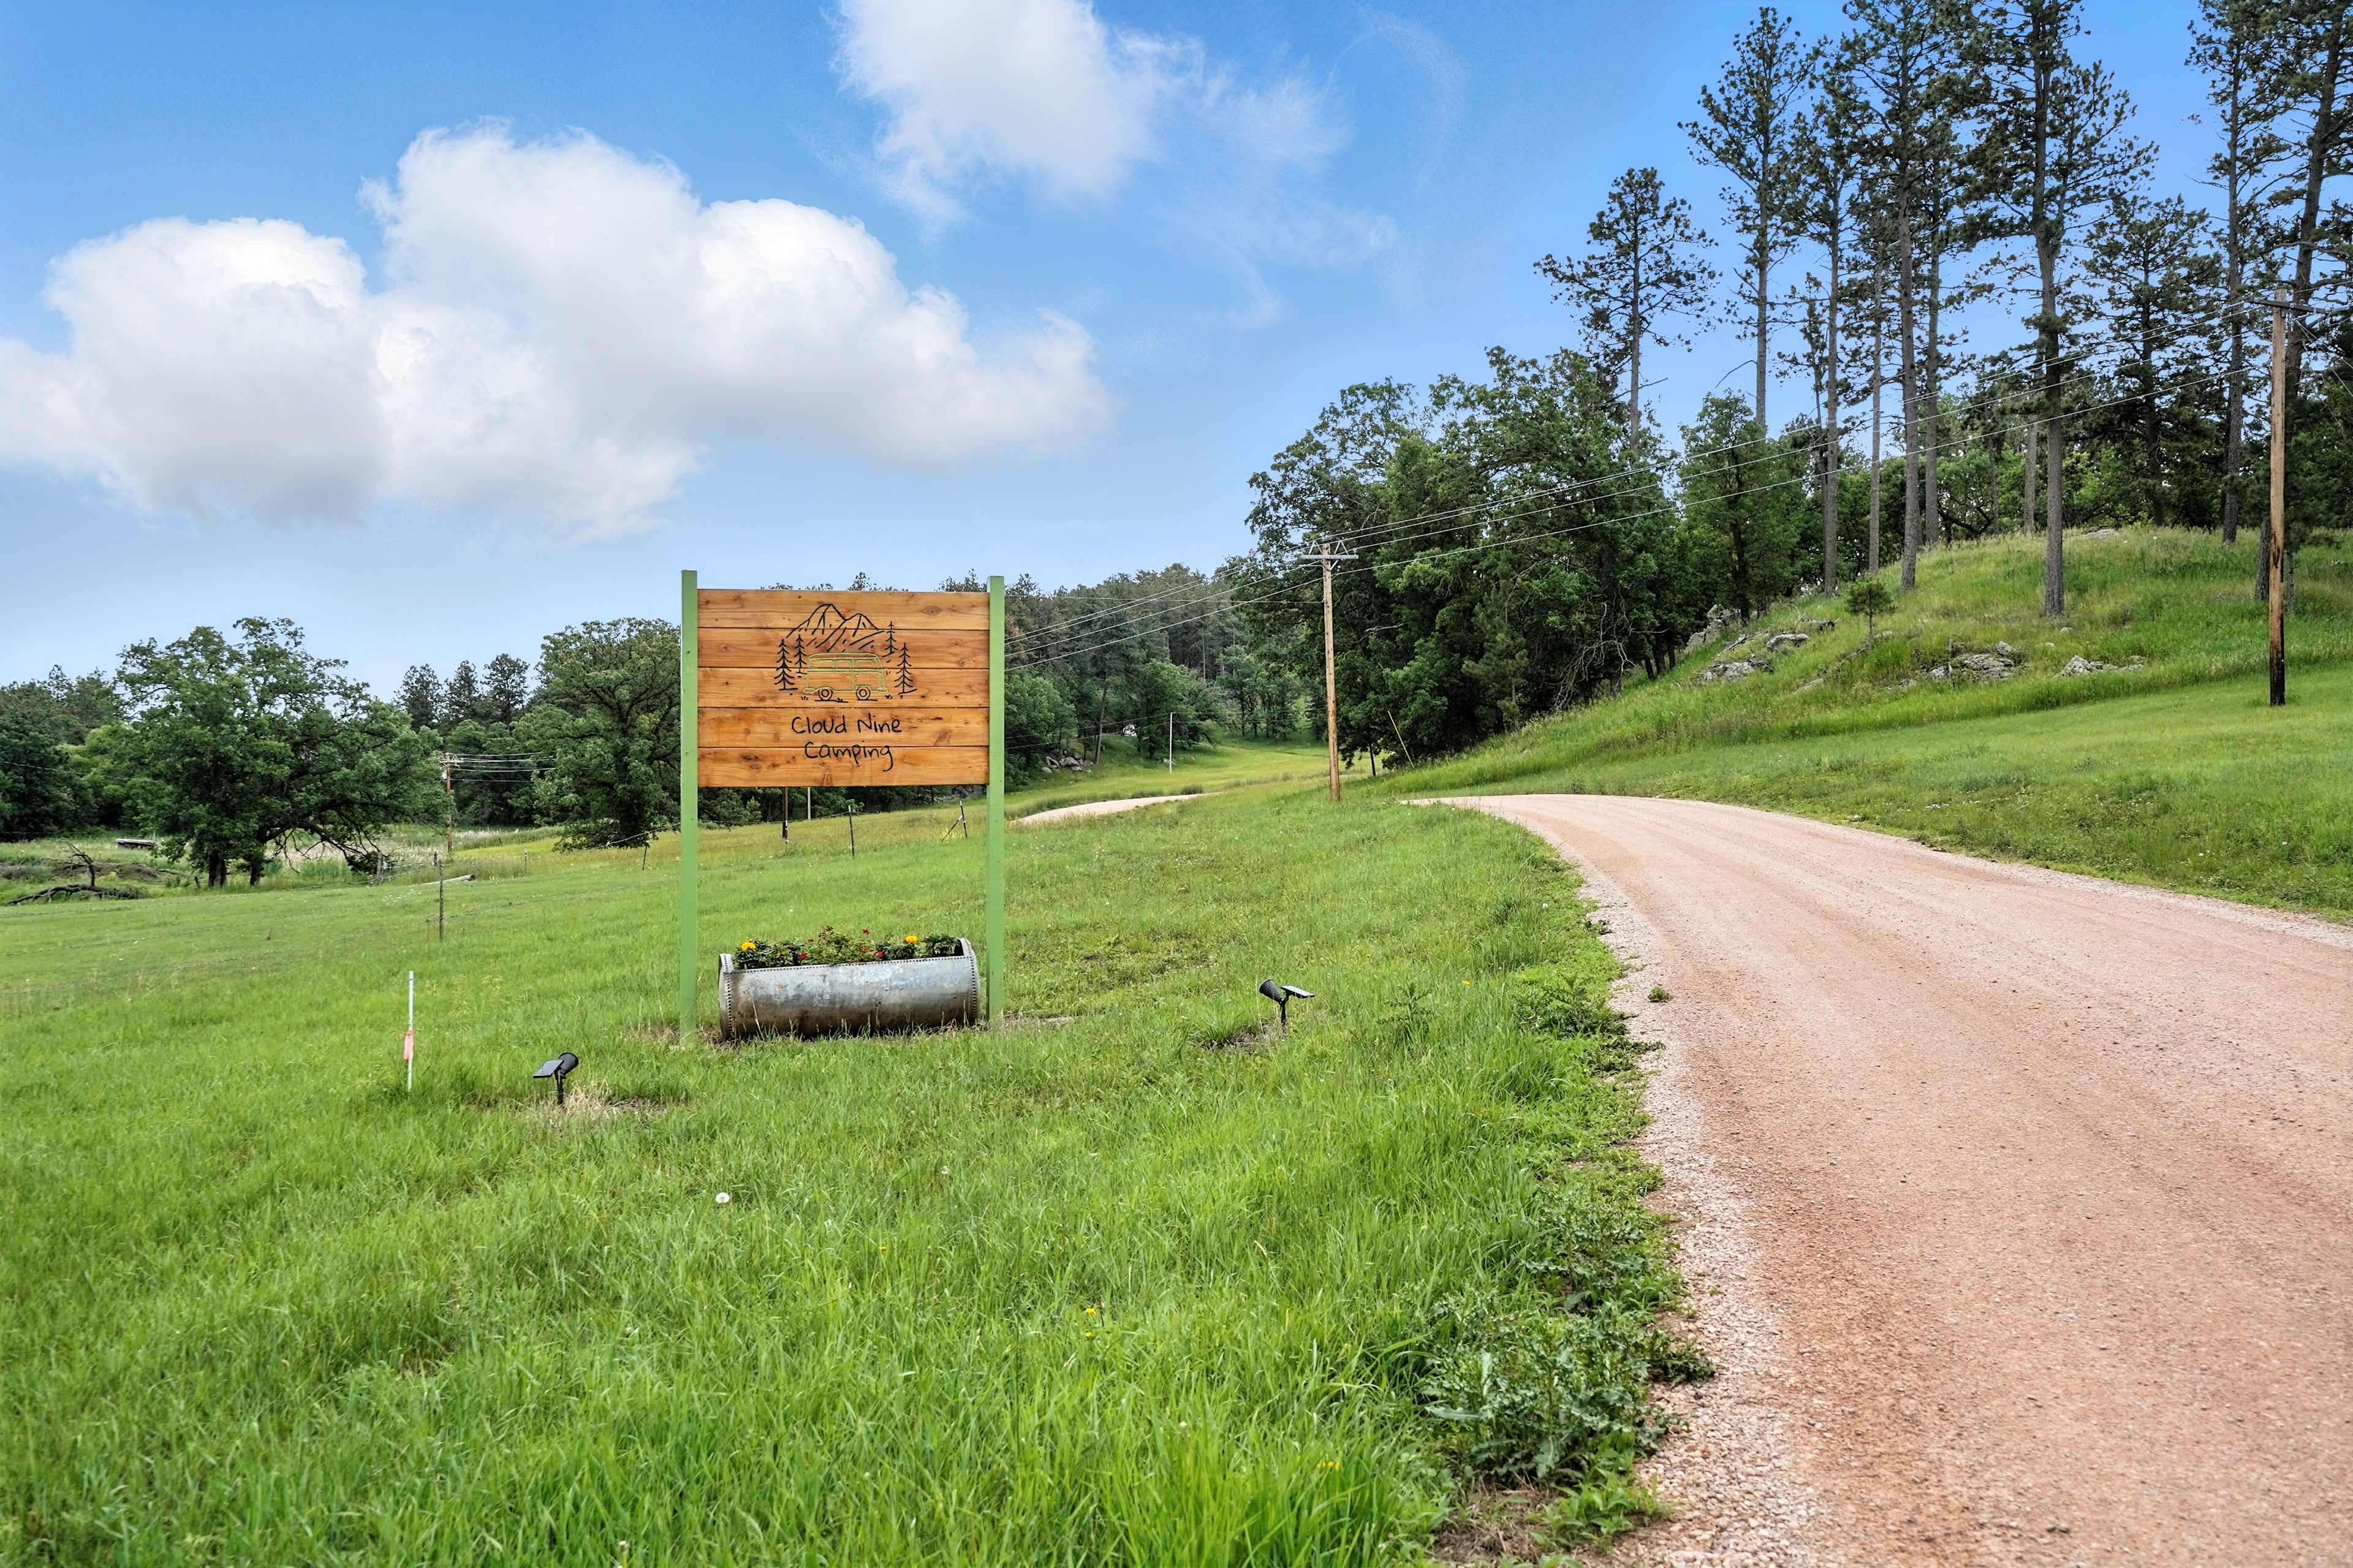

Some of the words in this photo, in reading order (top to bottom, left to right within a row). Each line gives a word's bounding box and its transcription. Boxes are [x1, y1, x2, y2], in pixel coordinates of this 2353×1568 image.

[792, 715, 847, 735] Cloud
[858, 713, 903, 733] Nine
[804, 740, 893, 772] Camping
